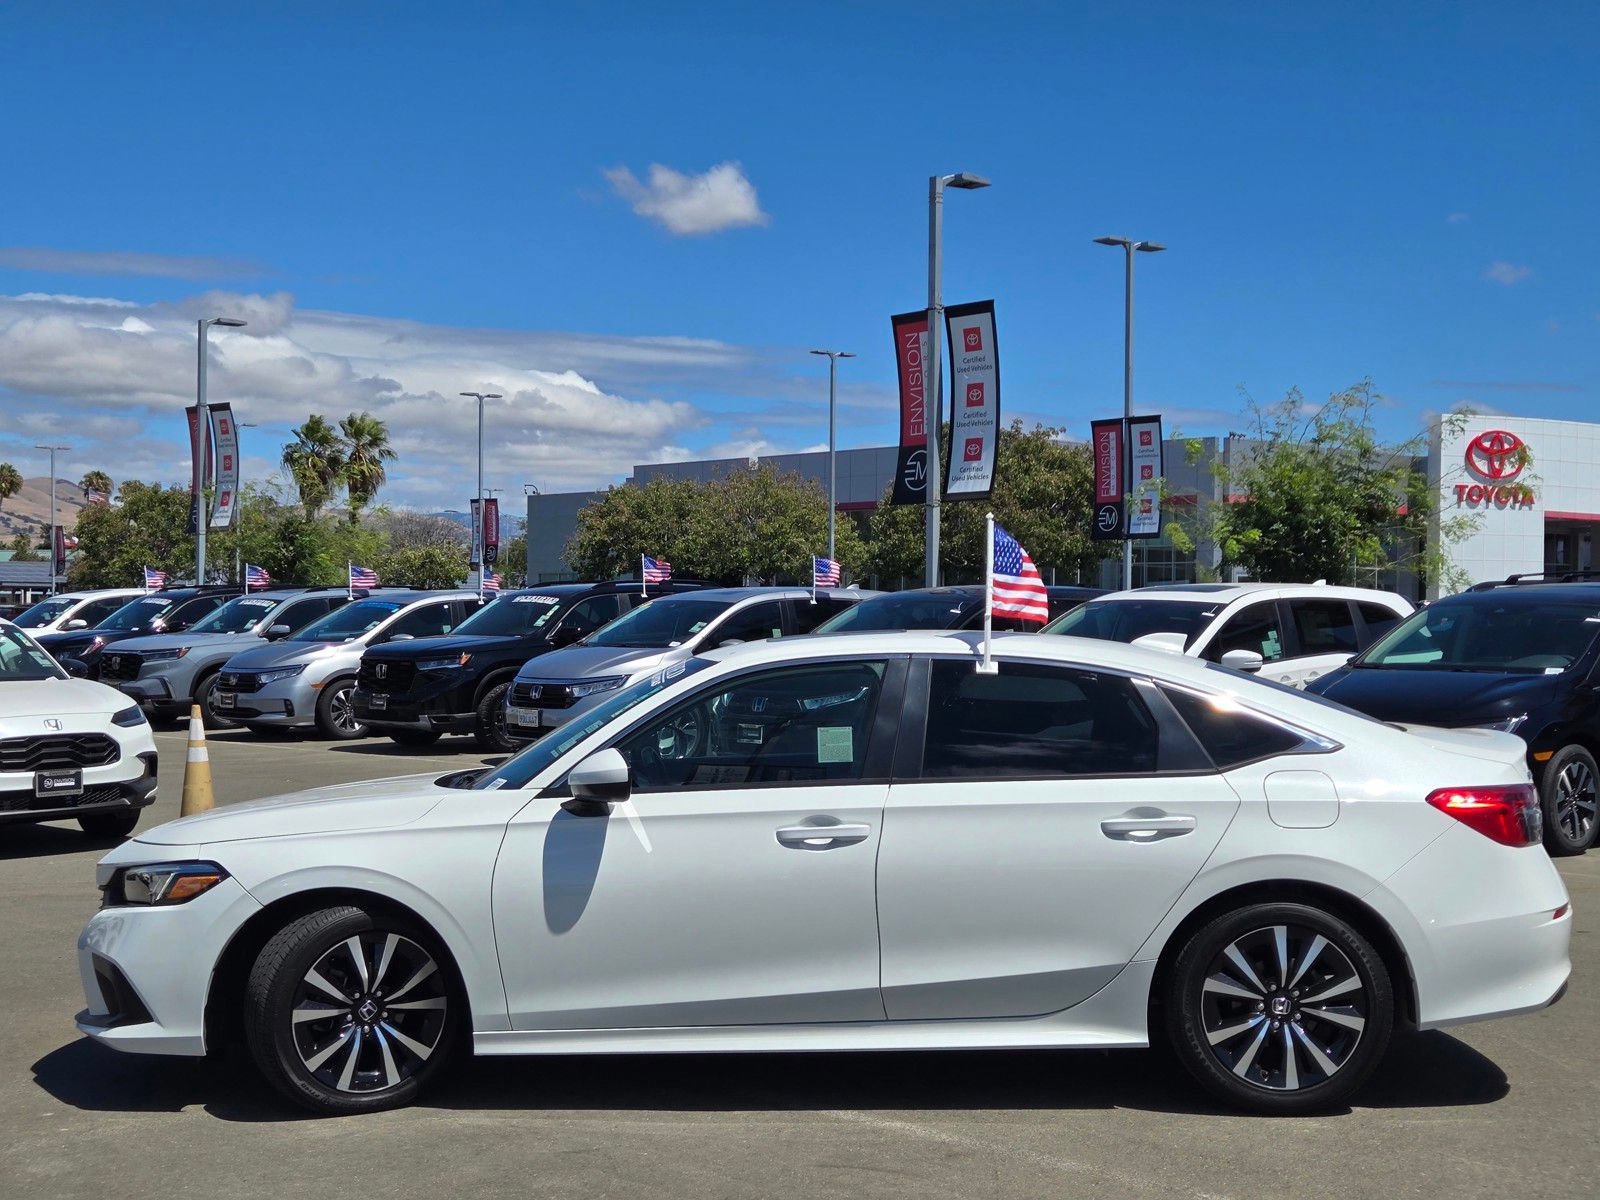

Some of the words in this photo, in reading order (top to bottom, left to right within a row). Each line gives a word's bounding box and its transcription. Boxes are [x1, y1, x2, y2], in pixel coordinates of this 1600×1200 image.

[962, 355, 986, 364] Certified
[956, 365, 972, 374] Used
[971, 364, 993, 373] Vehicles
[905, 332, 922, 436] ENVISION
[963, 411, 988, 420] Certified
[956, 419, 971, 428] Used
[970, 418, 993, 427] Vehicles
[959, 465, 984, 474] Certified
[1100, 432, 1111, 497] ENVISION
[951, 473, 966, 482] Used
[966, 473, 989, 482] Vehicles
[1454, 484, 1536, 506] TOYOTA
